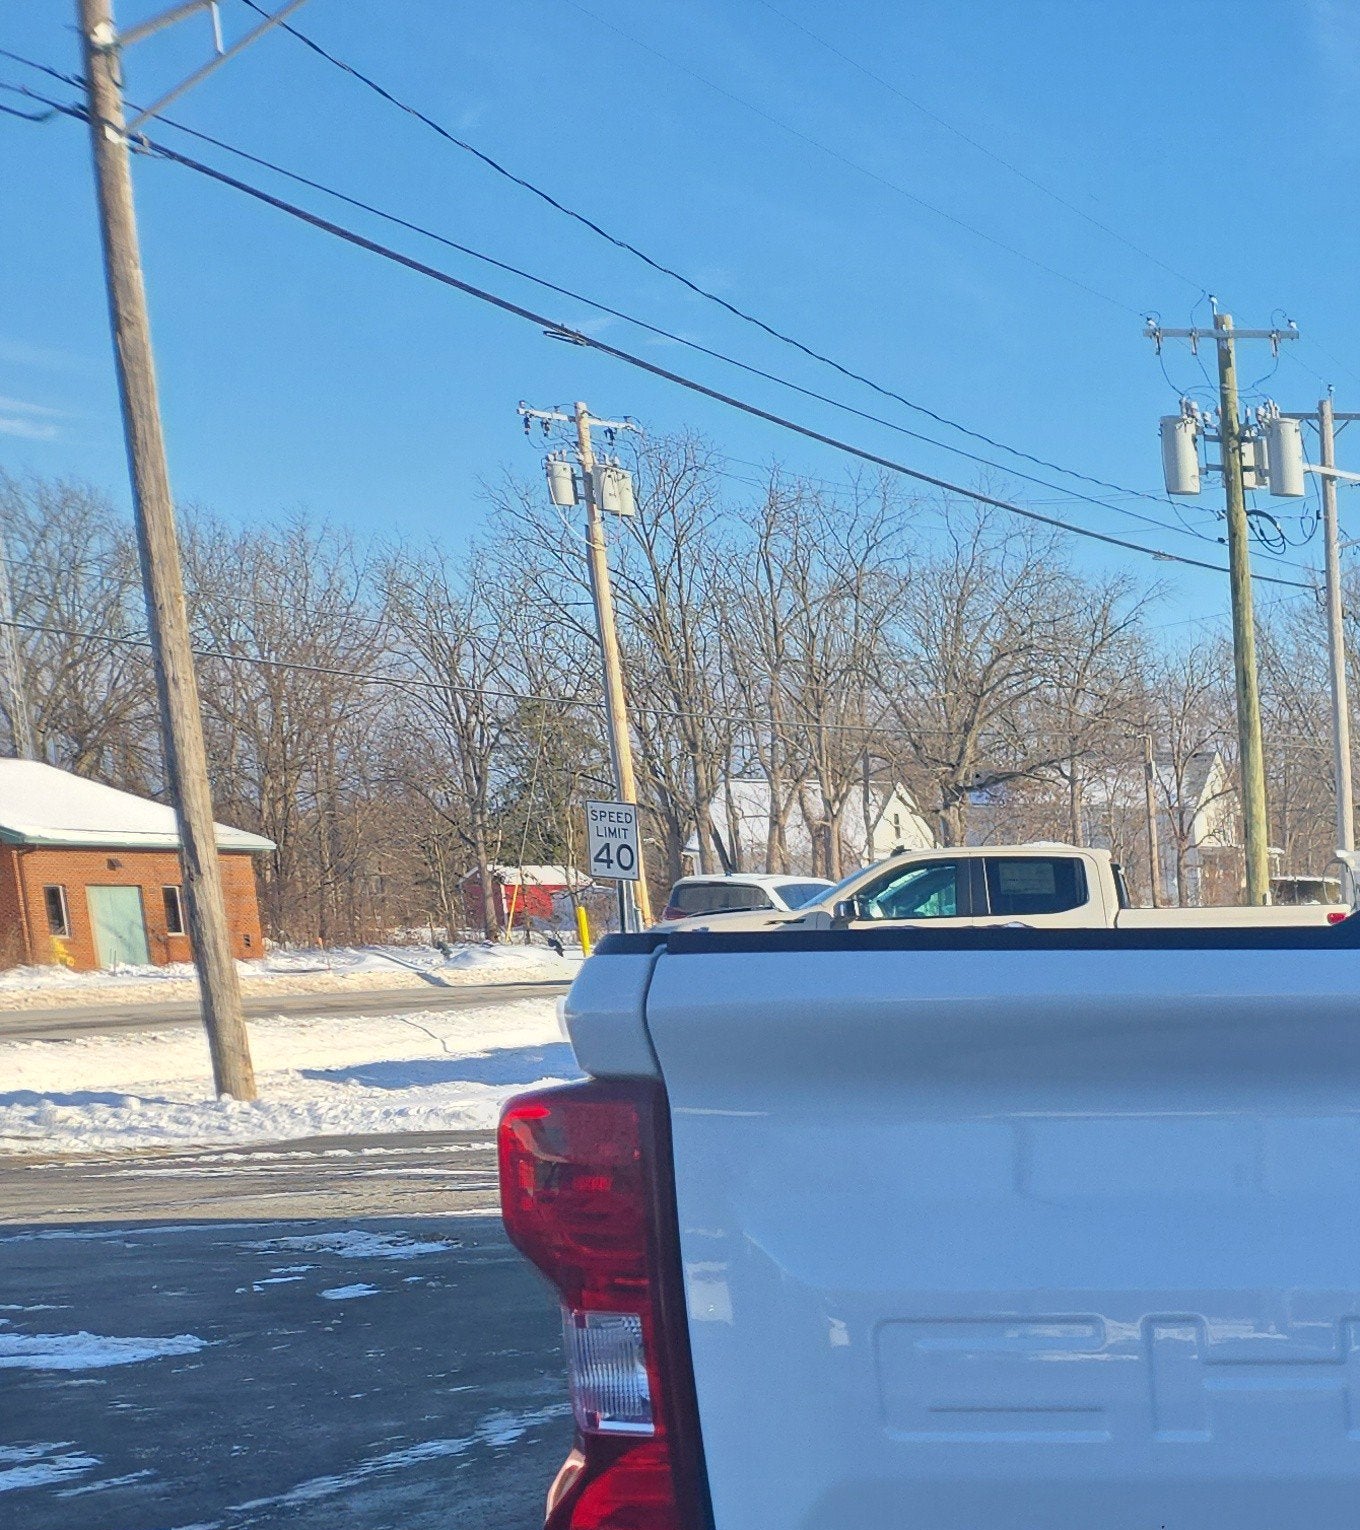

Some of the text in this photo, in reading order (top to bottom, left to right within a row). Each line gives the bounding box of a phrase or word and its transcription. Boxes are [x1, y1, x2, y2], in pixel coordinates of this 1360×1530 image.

[590, 809, 633, 824] SPEED
[595, 825, 629, 839] LIMIT
[593, 842, 635, 871] 40
